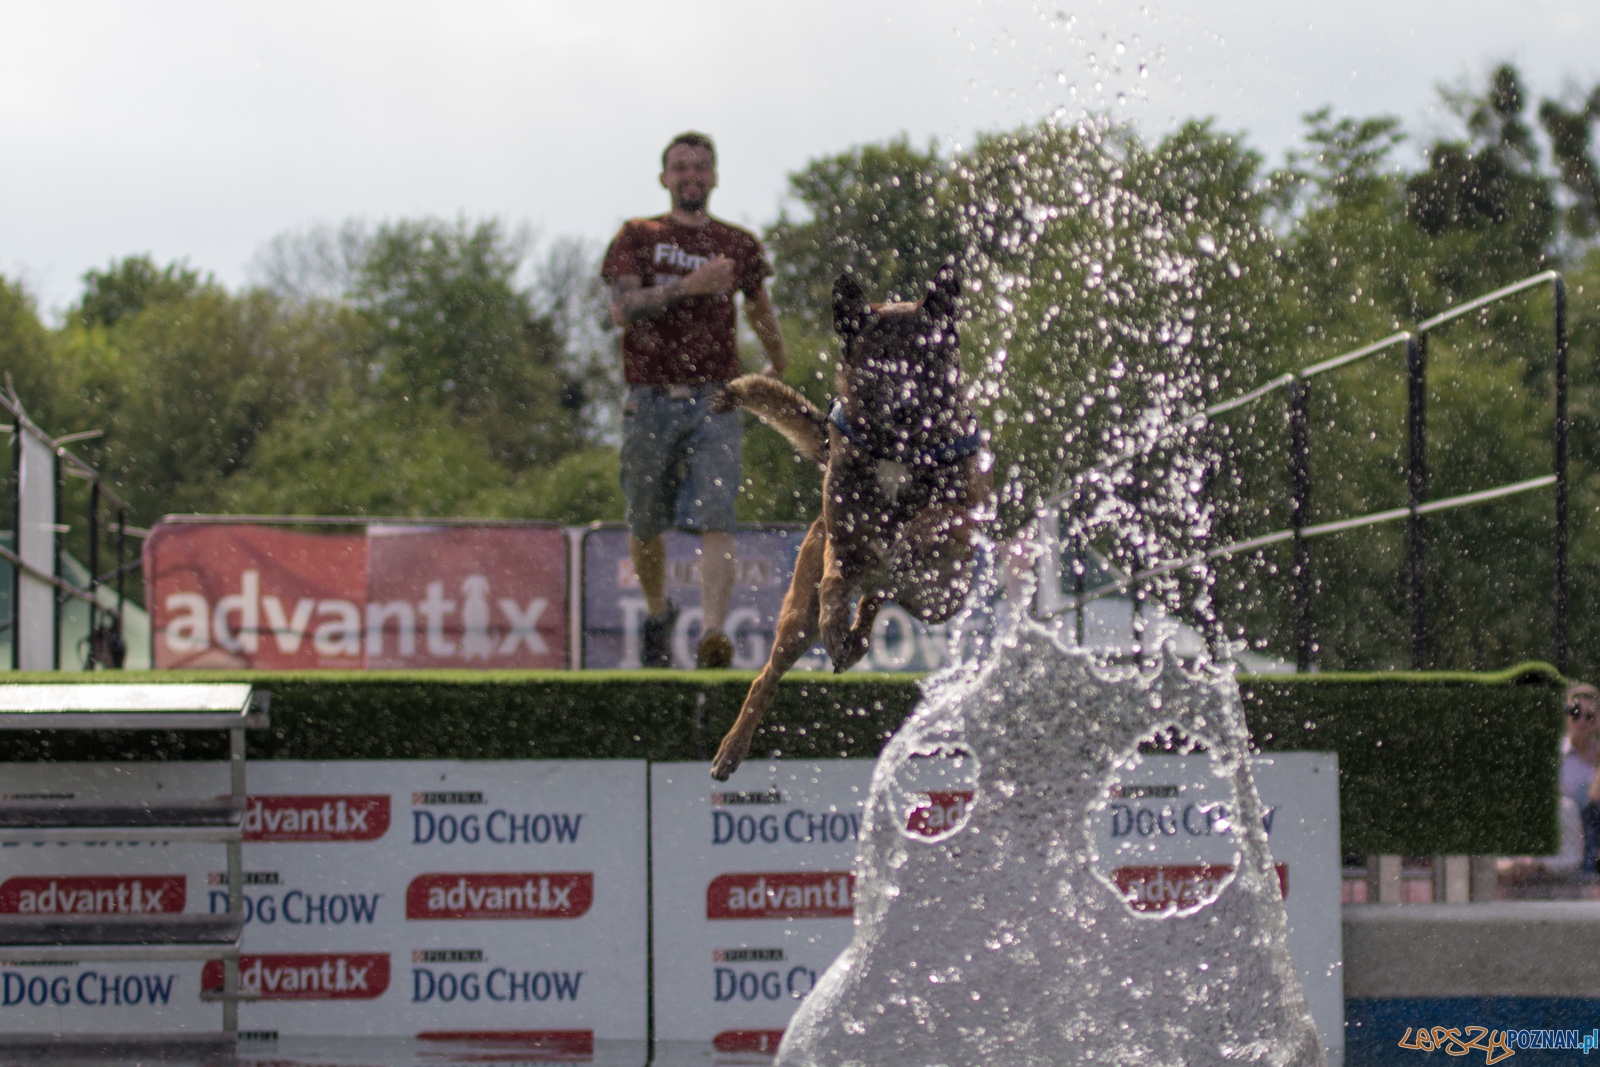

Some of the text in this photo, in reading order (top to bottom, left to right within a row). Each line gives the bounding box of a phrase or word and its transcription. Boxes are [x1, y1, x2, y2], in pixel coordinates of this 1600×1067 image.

[246, 800, 368, 833] dvantix
[728, 877, 855, 910] advanti
[238, 959, 368, 992] dvantix
